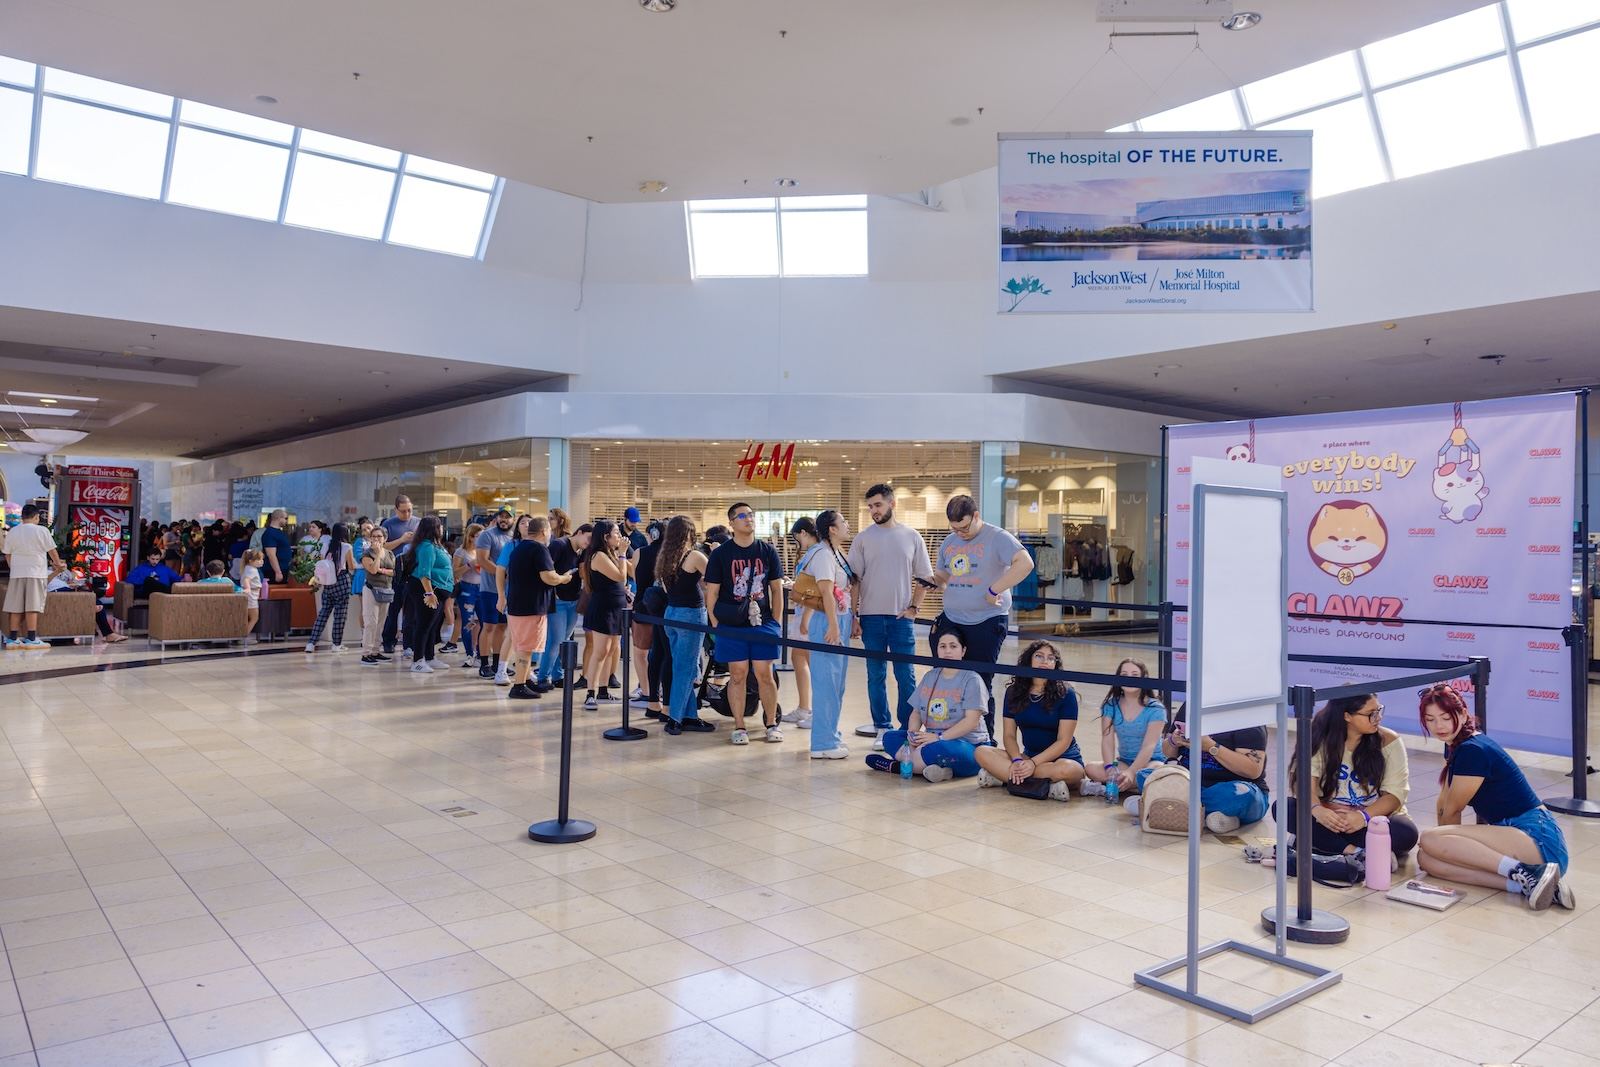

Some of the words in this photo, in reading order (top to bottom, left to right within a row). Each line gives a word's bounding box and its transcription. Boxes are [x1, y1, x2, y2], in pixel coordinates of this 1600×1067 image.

[1027, 152, 1056, 164] The
[1061, 151, 1121, 166] hospital
[1127, 150, 1153, 163] OF
[1159, 149, 1196, 163] THE
[1202, 149, 1283, 163] FUTURE.
[1071, 271, 1119, 288] Jackson
[1119, 271, 1147, 285] West
[1174, 268, 1194, 281] José
[1195, 268, 1225, 279] Milton
[1159, 281, 1201, 290] Memorial
[1203, 280, 1240, 292] Hospital
[1328, 441, 1347, 449] place
[1529, 448, 1561, 457] CLAWZ
[736, 442, 796, 481] H&M
[1282, 450, 1416, 478] everybody
[1312, 472, 1383, 494] wins!
[82, 484, 130, 500] Coca-Cola
[1528, 496, 1561, 505] CLAWZ
[1408, 528, 1435, 536] CLAWZ
[1476, 527, 1506, 535] CLAWZ
[1528, 545, 1560, 553] CLAWZ
[1433, 575, 1488, 589] CLAWZ
[1528, 593, 1560, 601] CLAWZ
[1288, 592, 1404, 628] CLAWZ
[1447, 631, 1476, 640] CLAWZ
[1527, 641, 1560, 650] CLAWZ
[1527, 688, 1560, 699] CLAWZ
